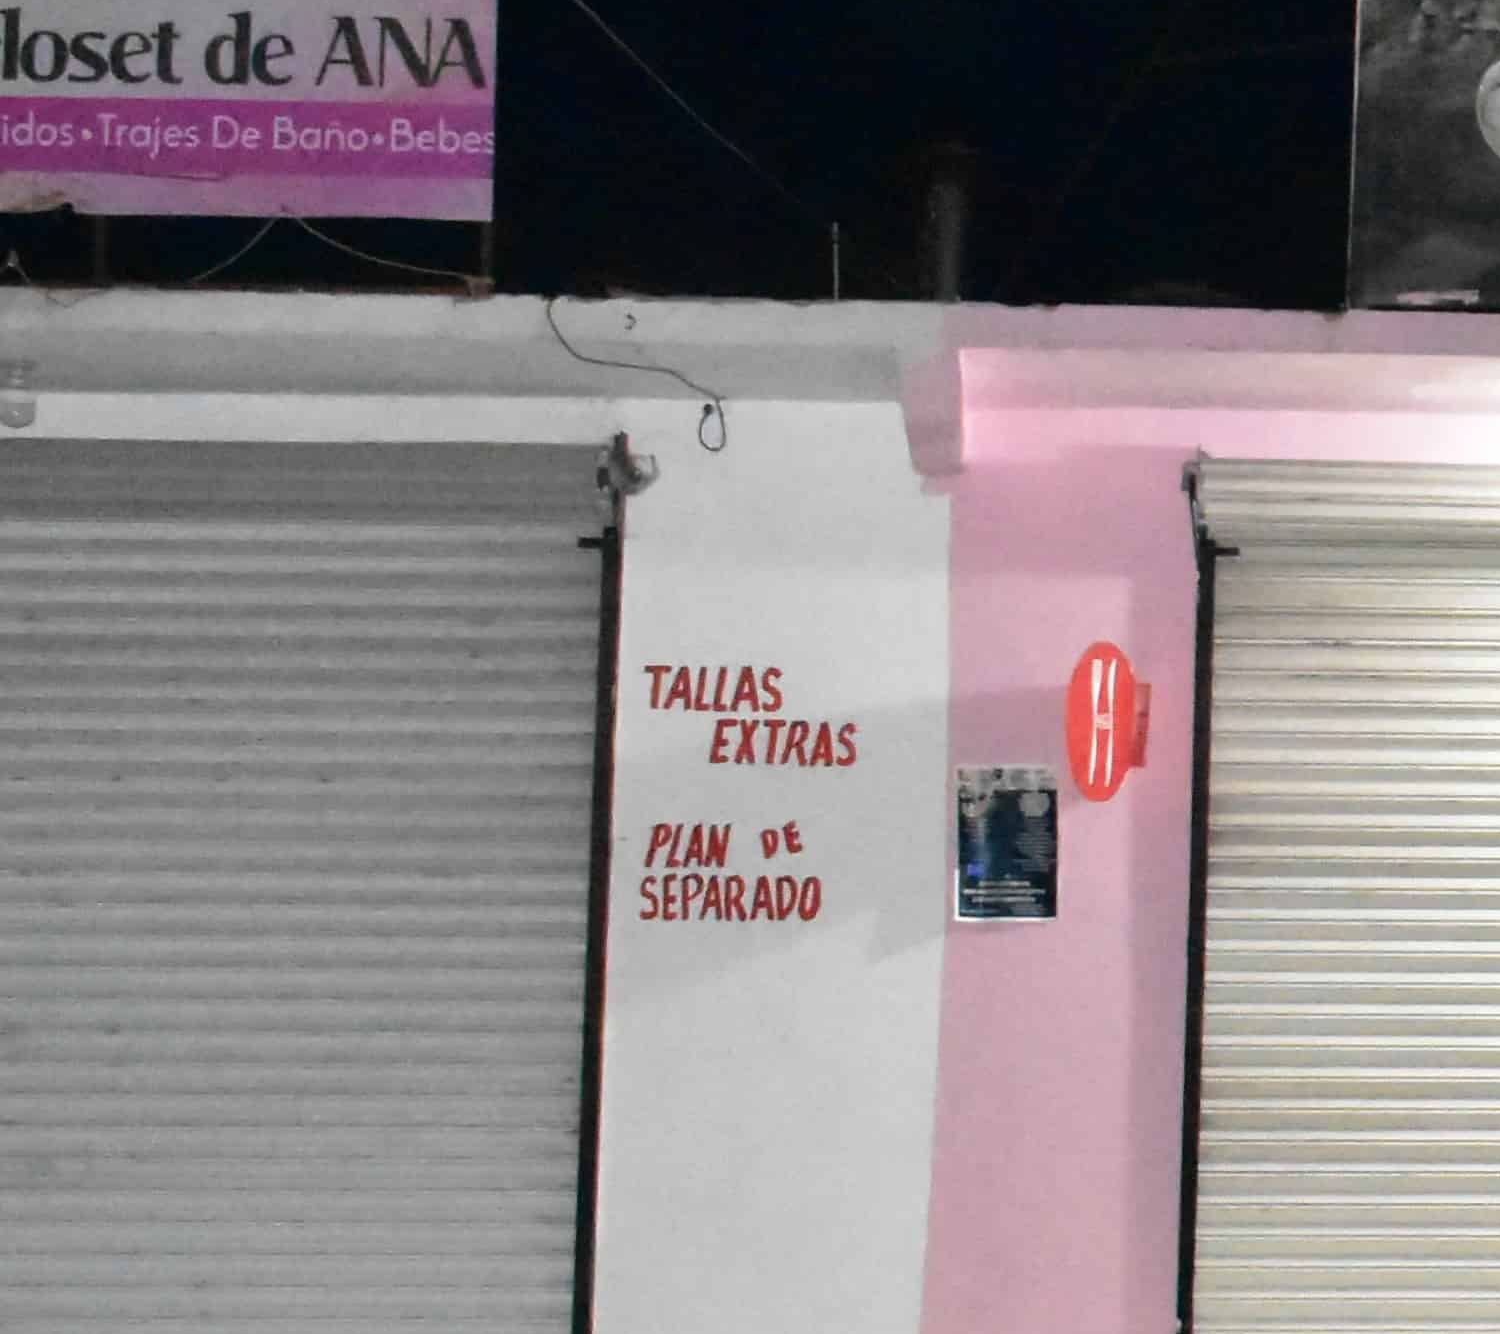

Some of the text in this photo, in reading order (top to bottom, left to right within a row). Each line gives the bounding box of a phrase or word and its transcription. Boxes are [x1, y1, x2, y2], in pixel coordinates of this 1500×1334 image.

[0, 6, 487, 90] loset de ANA
[97, 112, 200, 160] Trajes
[211, 115, 262, 150] De
[272, 115, 369, 152] Baño
[390, 117, 495, 155] Bebes
[643, 663, 784, 713] TALLAS
[708, 718, 860, 768] EXTRAS
[643, 820, 804, 869] PLAN DE
[639, 873, 823, 923] SEPARADO
